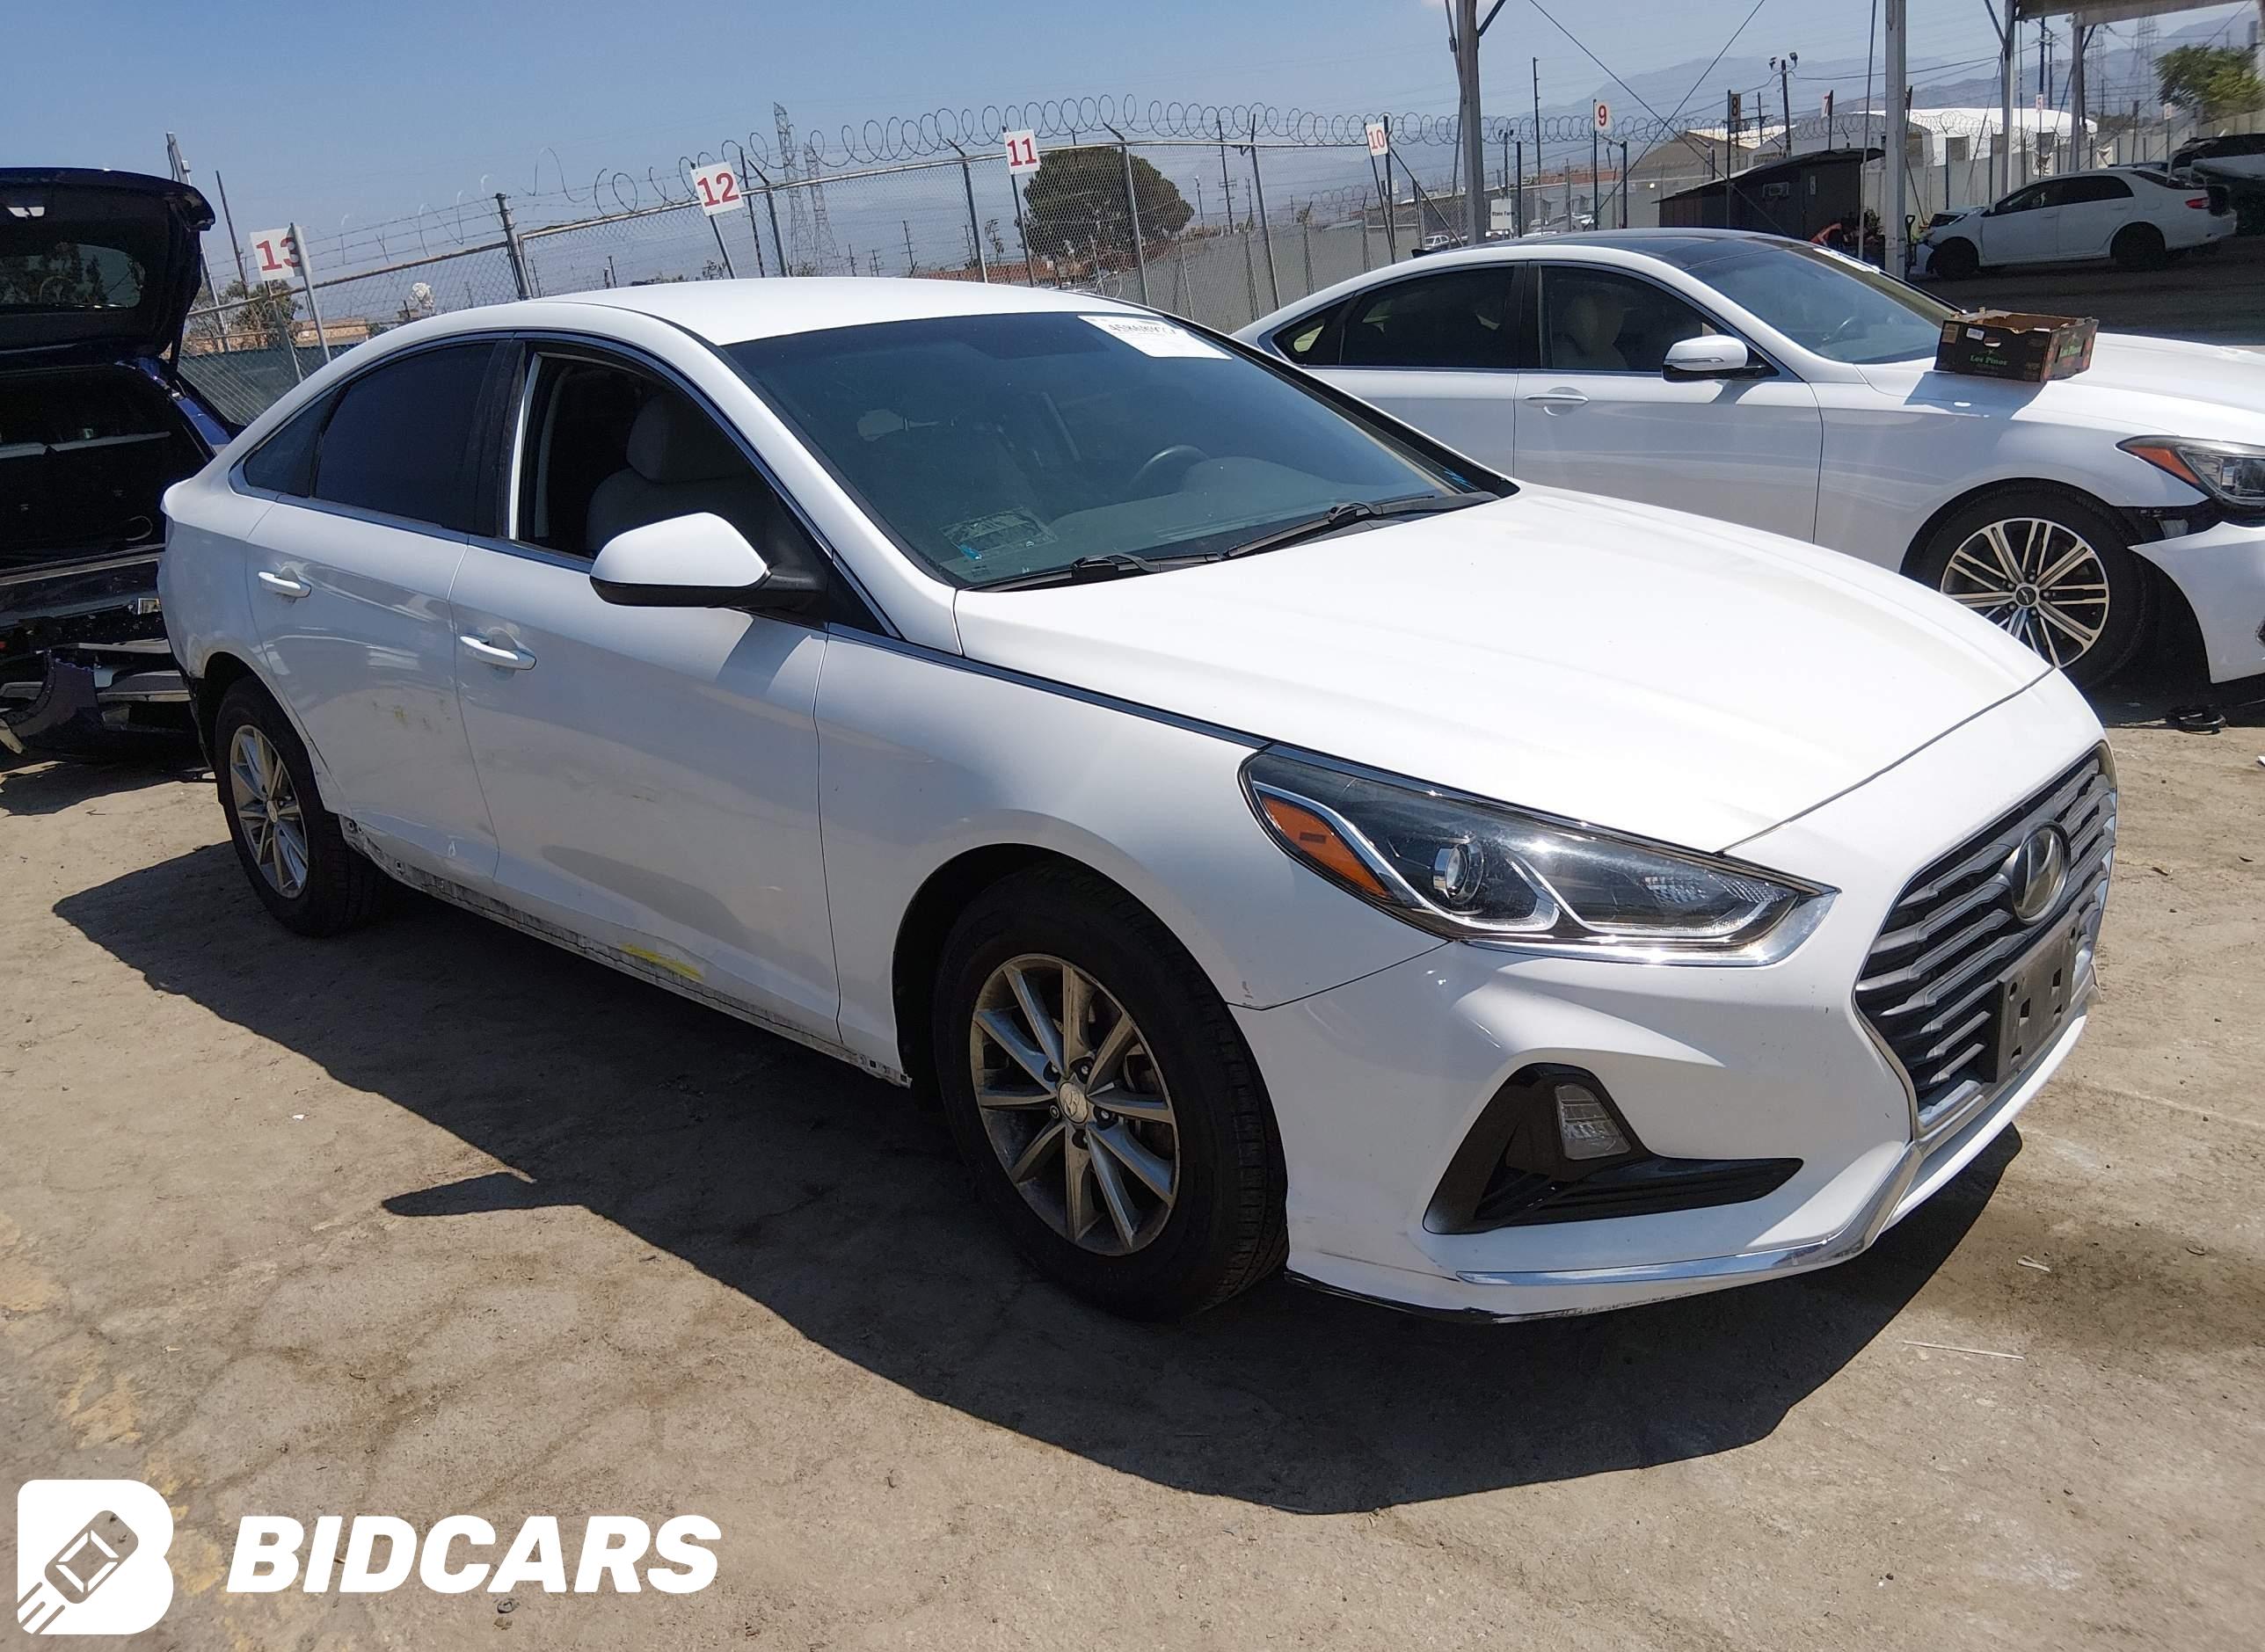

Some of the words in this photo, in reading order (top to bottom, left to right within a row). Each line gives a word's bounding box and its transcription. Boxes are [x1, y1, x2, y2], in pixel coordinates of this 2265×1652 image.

[1598, 105, 1607, 127] 9
[1731, 97, 1738, 116] 8
[1368, 129, 1385, 149] 10
[1007, 138, 1037, 166] 11
[697, 172, 739, 207] 12
